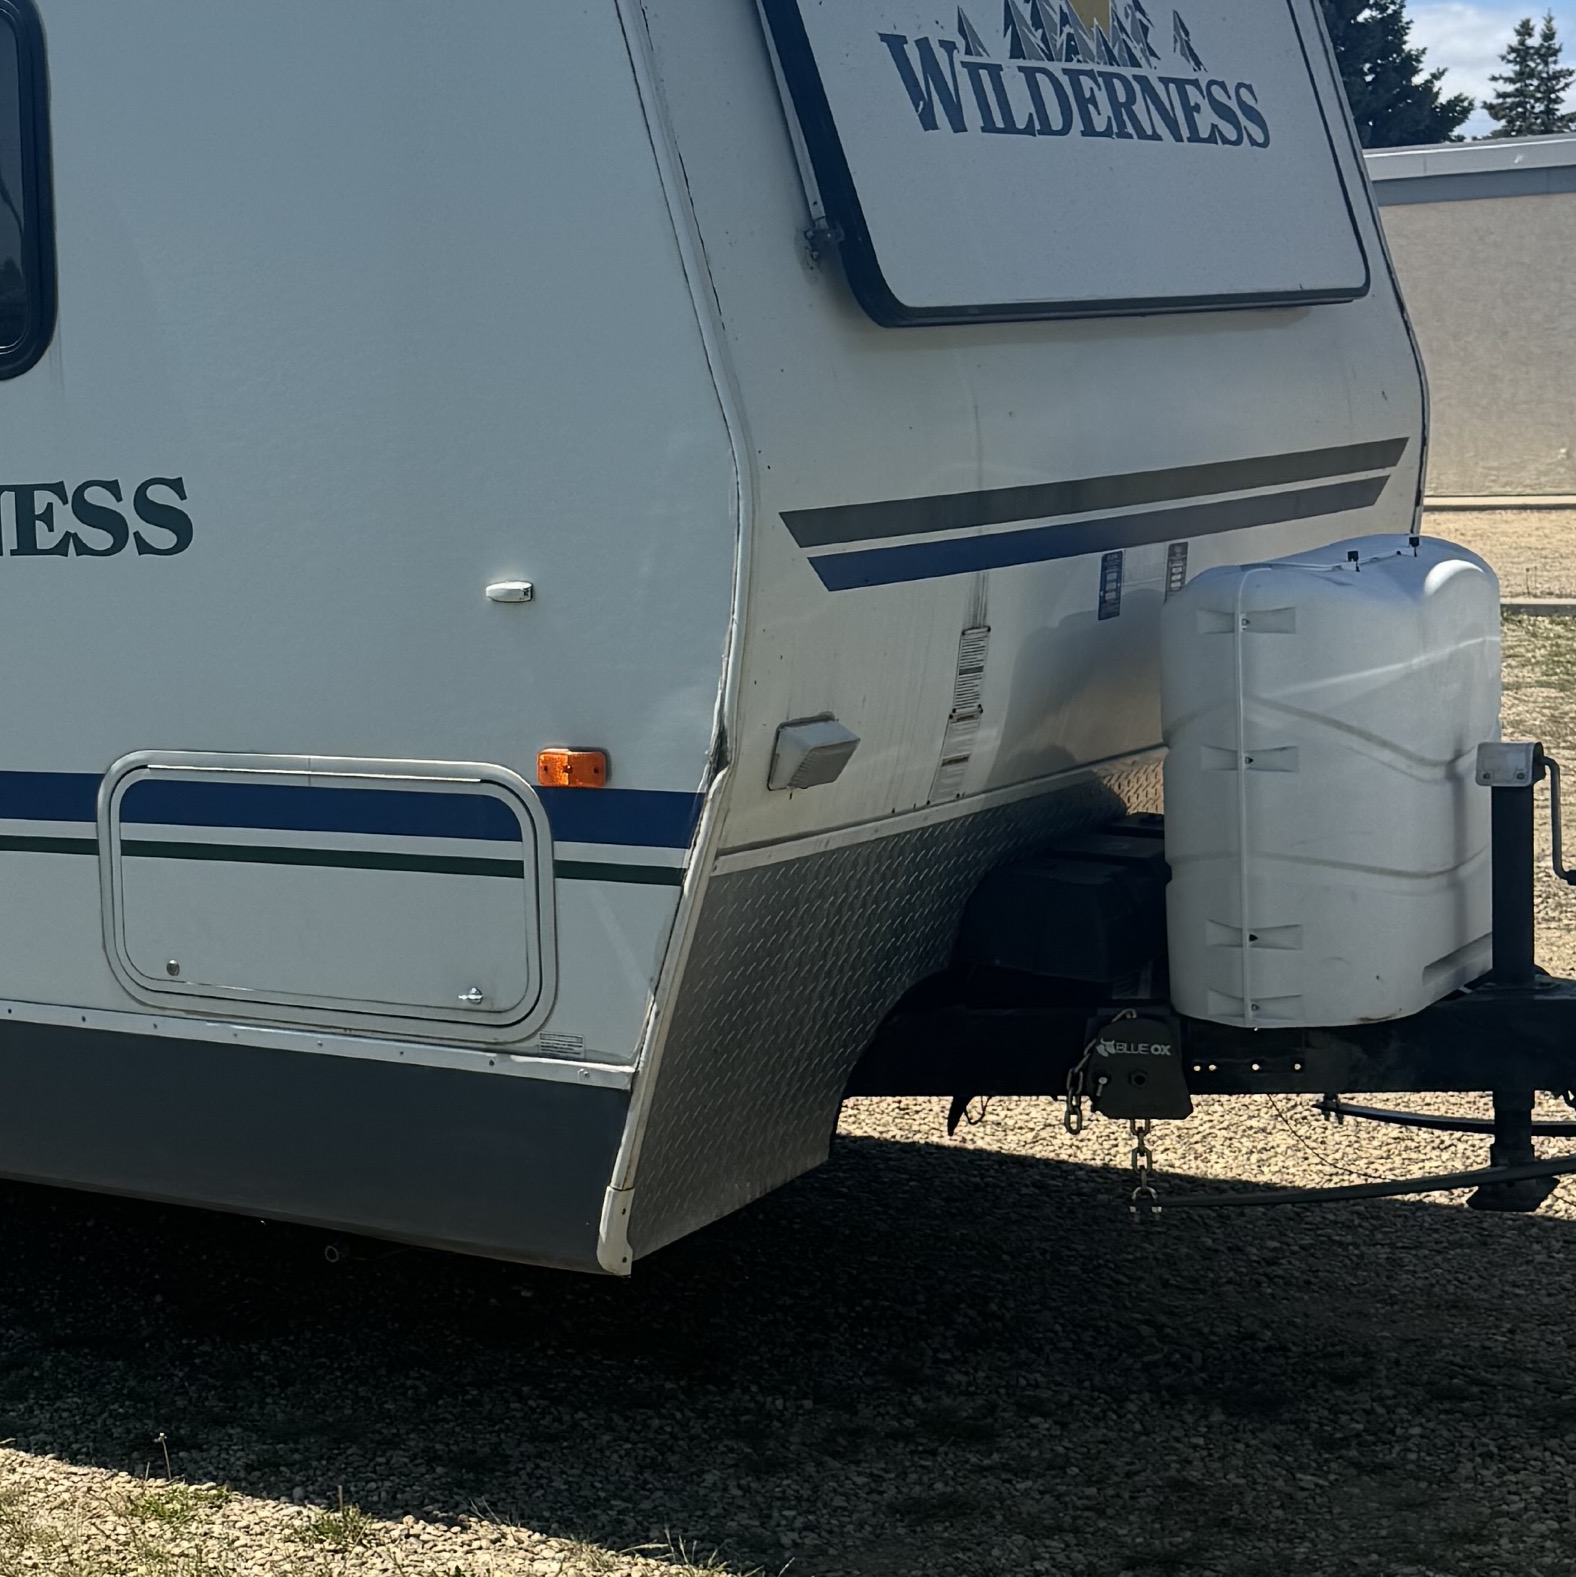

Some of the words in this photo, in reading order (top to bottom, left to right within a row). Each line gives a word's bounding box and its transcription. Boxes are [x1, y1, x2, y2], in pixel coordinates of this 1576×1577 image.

[877, 31, 1271, 149] WILDERNESS
[1116, 1042, 1149, 1055] BLUE
[1150, 1044, 1171, 1056] OX
